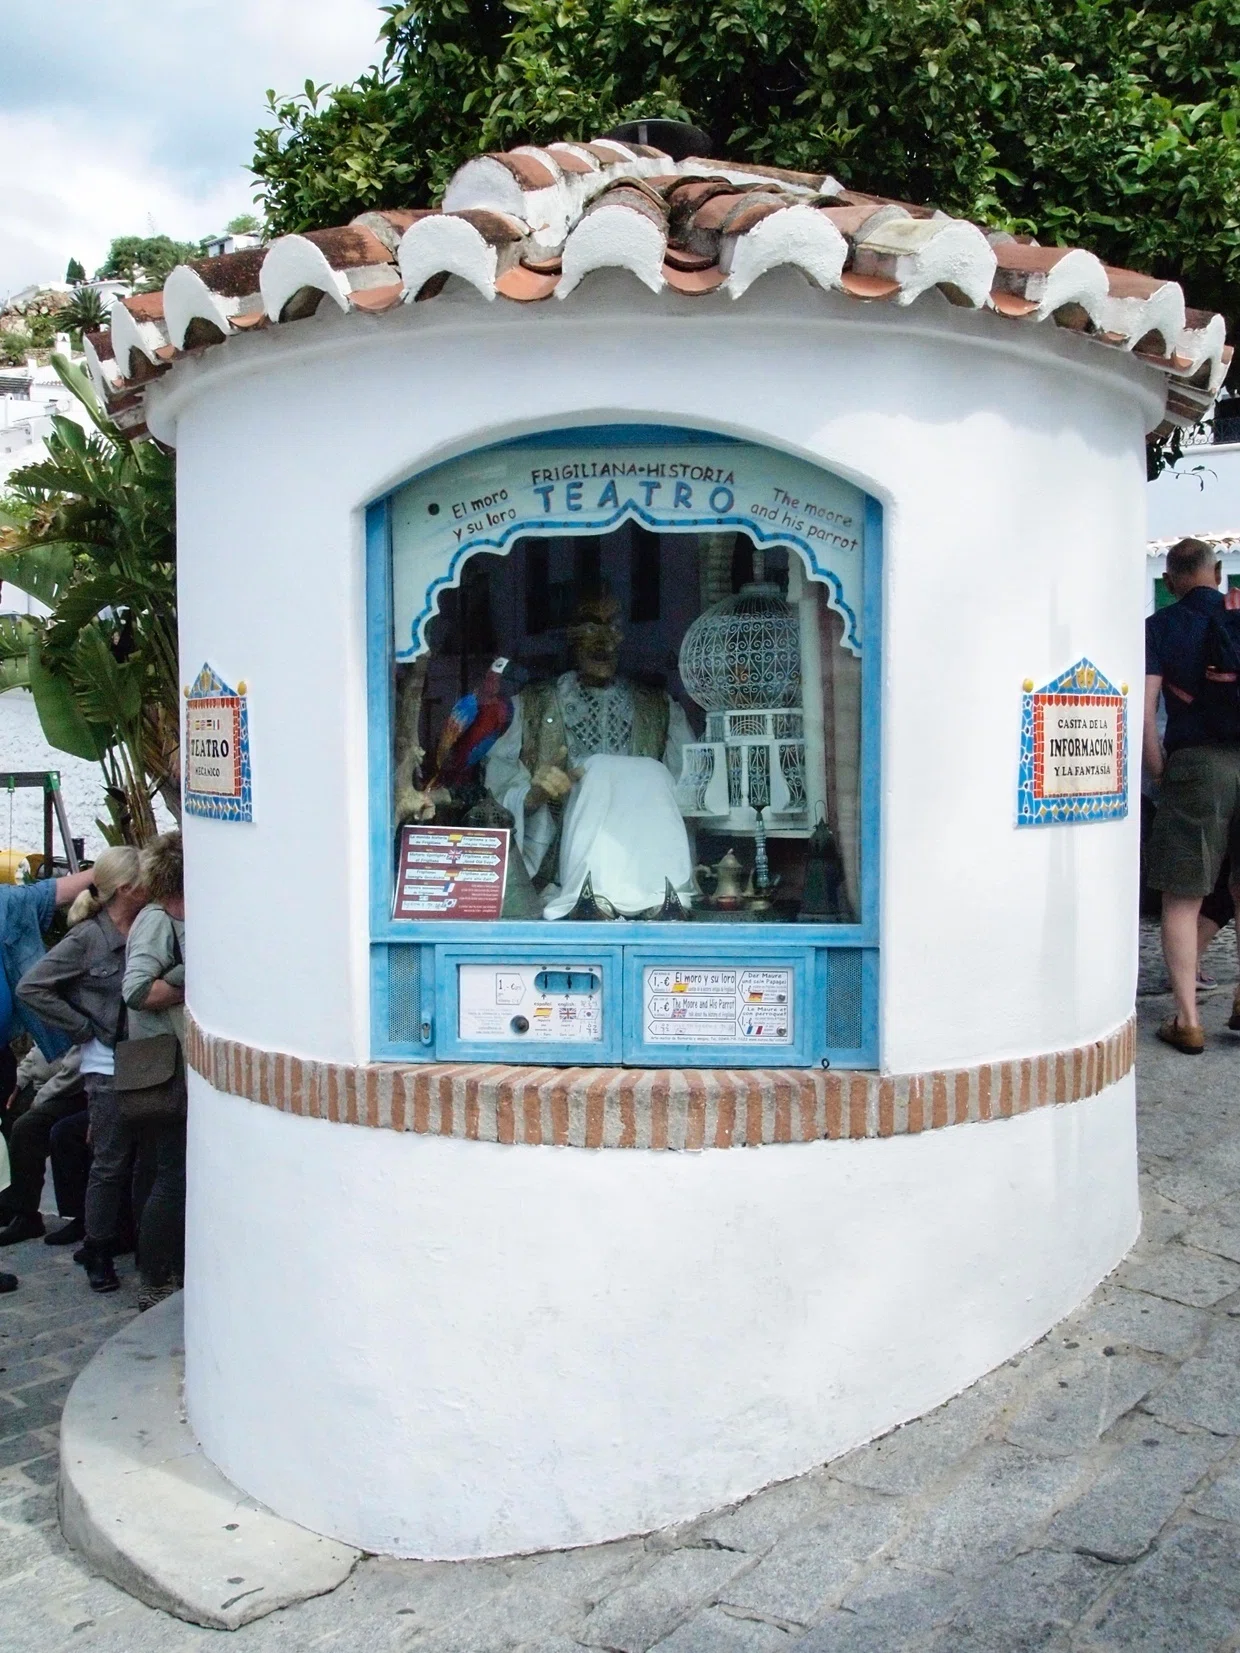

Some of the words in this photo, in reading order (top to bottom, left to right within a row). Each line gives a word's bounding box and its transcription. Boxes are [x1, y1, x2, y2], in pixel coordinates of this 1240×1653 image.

[452, 500, 467, 520] El
[470, 488, 508, 512] moro
[533, 479, 735, 514] TEATRO
[773, 487, 800, 509] The
[803, 502, 853, 528] moore
[452, 527, 462, 543] y
[466, 521, 484, 535] su
[486, 508, 517, 527] loro
[750, 503, 779, 520] and
[782, 511, 804, 531] his
[806, 525, 859, 552] parrot
[1058, 719, 1088, 729] CASITA
[1089, 720, 1098, 729] DE
[1100, 720, 1108, 729] LA
[191, 738, 230, 758] TEATRO
[1050, 733, 1114, 758] INFORMACIÓN
[1054, 766, 1060, 776] Y
[1062, 766, 1073, 776] LA
[675, 972, 682, 982] El
[684, 974, 702, 984] moro
[703, 975, 709, 986] y
[710, 976, 720, 984] su
[721, 973, 736, 984] loro
[672, 998, 681, 1009] The
[682, 998, 698, 1009] Moore
[699, 998, 708, 1009] and
[710, 998, 718, 1009] His
[718, 998, 734, 1010] Parrot
